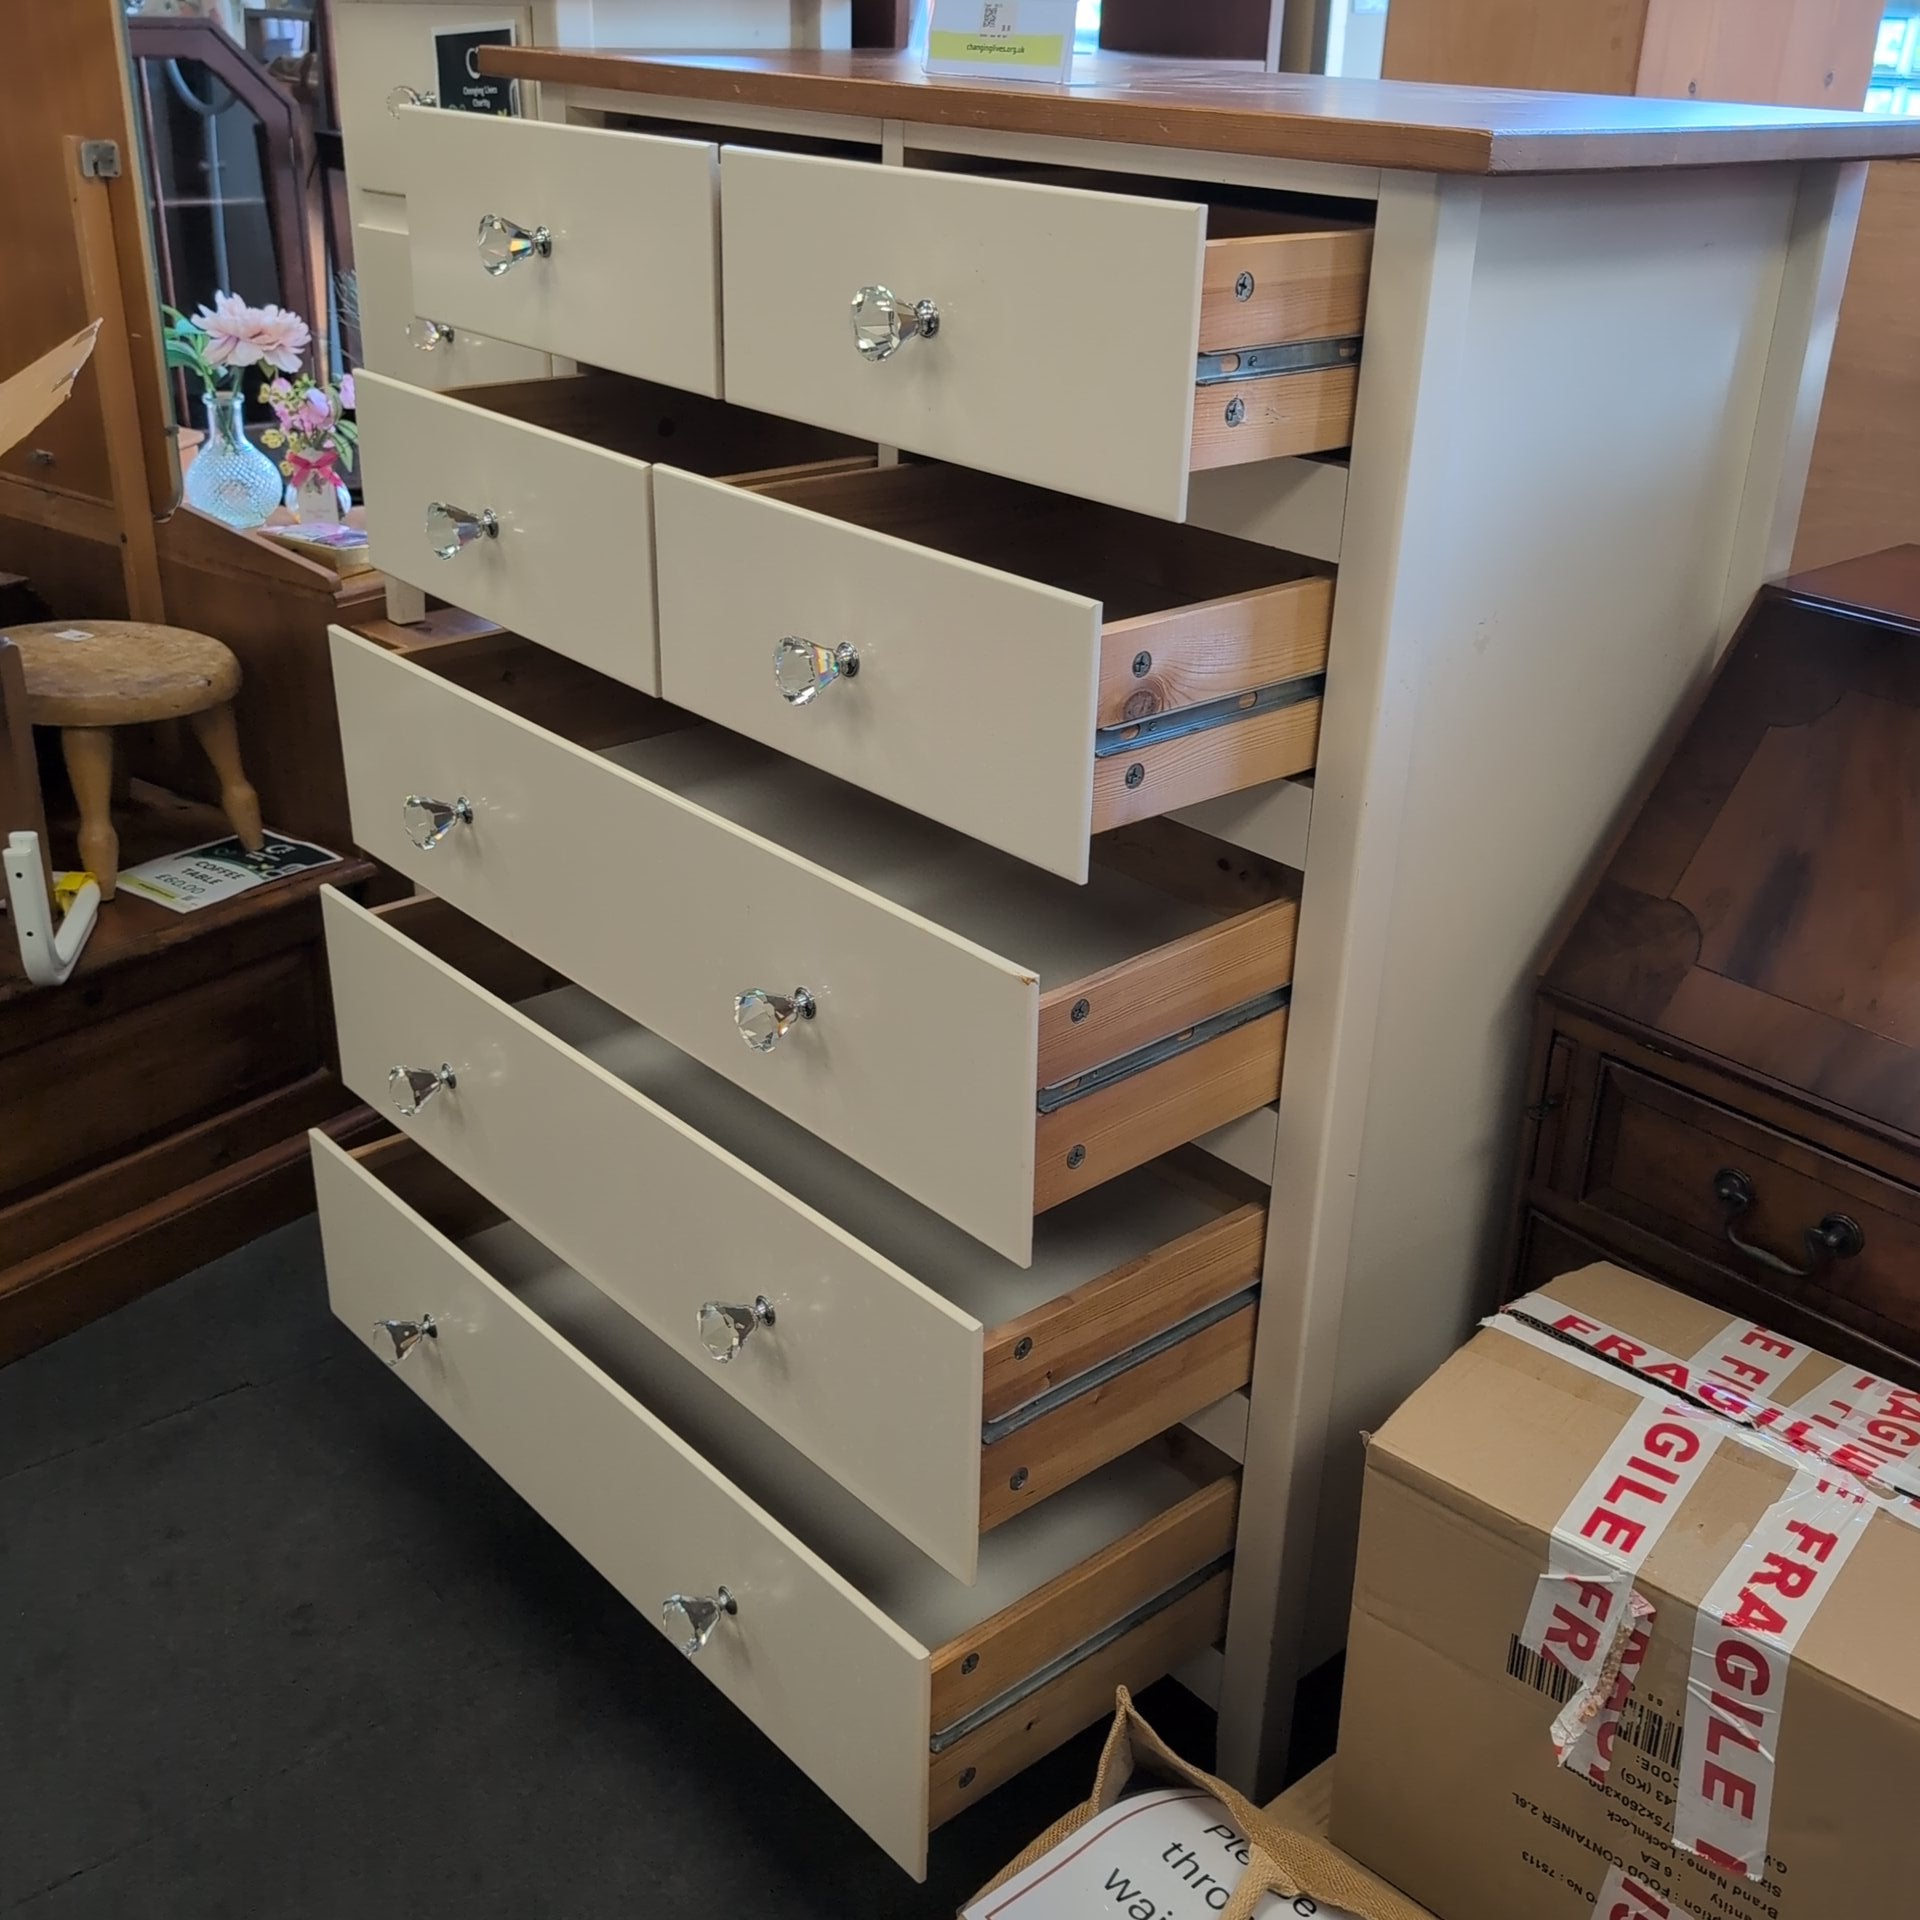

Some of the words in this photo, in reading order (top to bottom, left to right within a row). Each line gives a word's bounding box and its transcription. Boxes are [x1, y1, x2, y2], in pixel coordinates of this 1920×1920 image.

[155, 874, 206, 895] £60.00
[181, 867, 224, 886] TABLE
[195, 860, 245, 881] COFFEE
[1580, 1407, 1700, 1554] GILE
[1701, 1519, 1840, 1821] FRAGILE
[1620, 1767, 1652, 1795] (KG)
[1512, 1791, 1539, 1816] 2.6L
[1541, 1811, 1624, 1869] CONTAINER
[1606, 1808, 1677, 1860] LocknLock
[1521, 1850, 1556, 1879] 75113
[1628, 1864, 1671, 1899] FOOD
[1732, 1885, 1779, 1920] Brand
